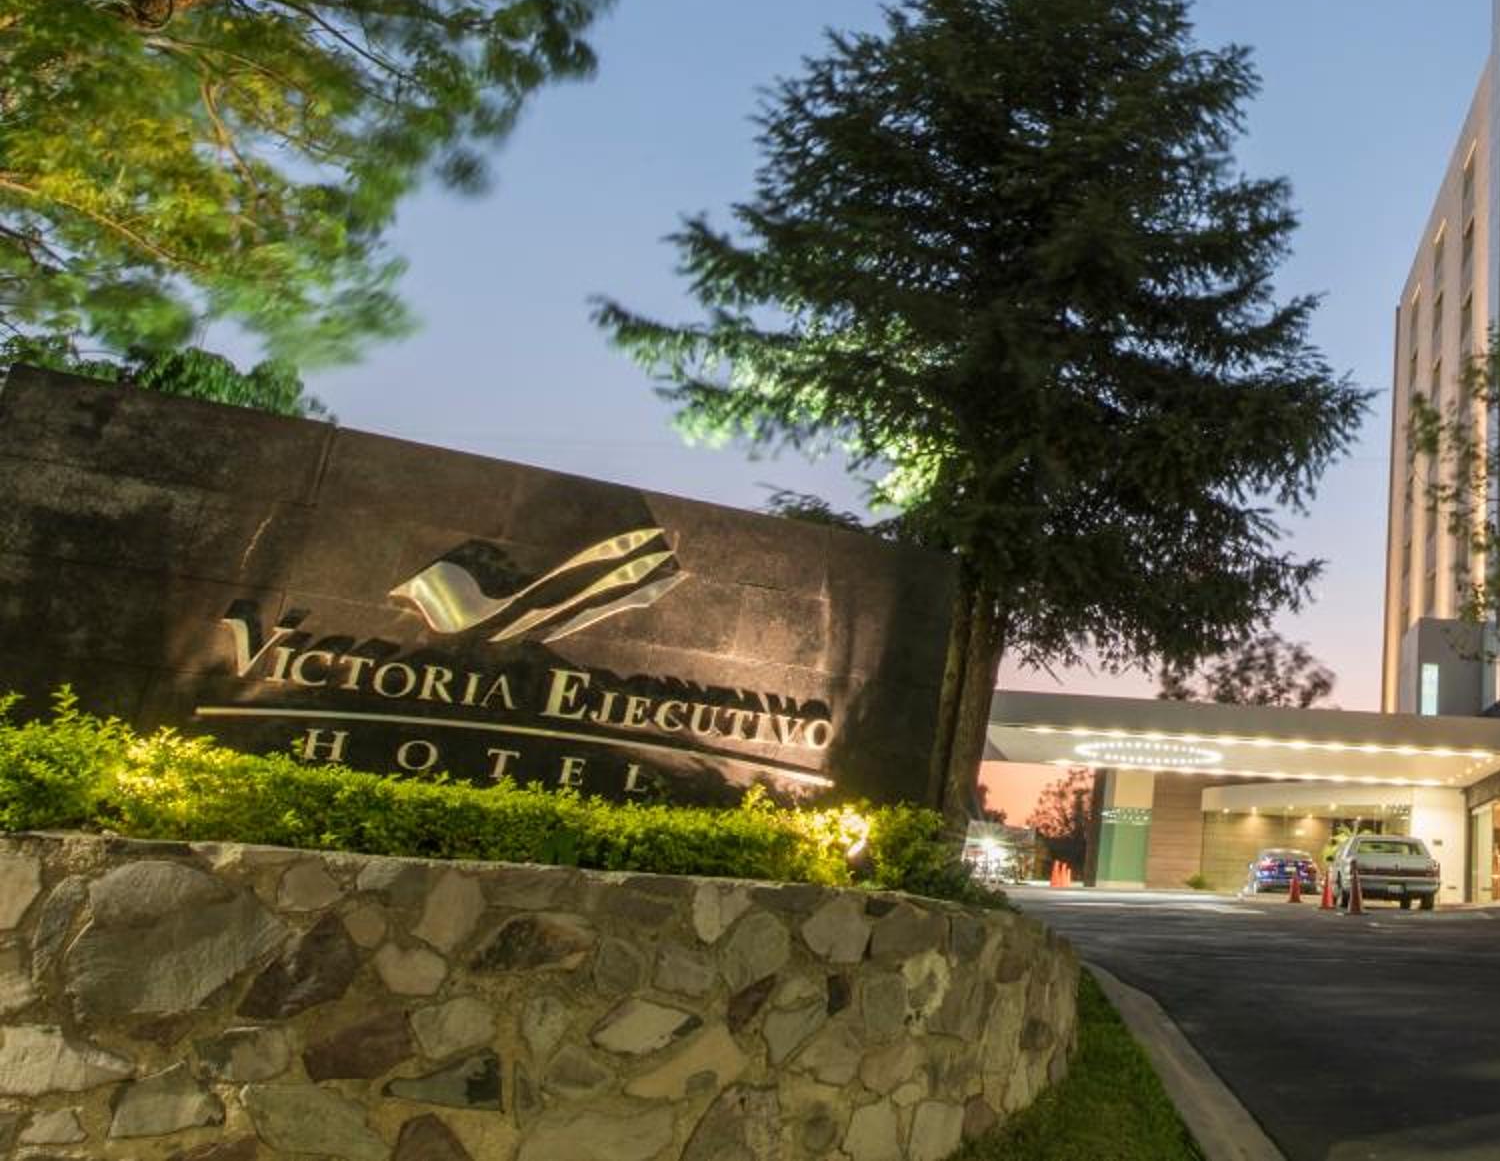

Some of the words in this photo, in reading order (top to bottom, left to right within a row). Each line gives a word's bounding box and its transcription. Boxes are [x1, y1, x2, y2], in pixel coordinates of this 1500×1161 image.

[220, 617, 517, 711] VICTORIA
[539, 667, 835, 751] EJECUTIVO
[302, 727, 650, 793] HOTEL
